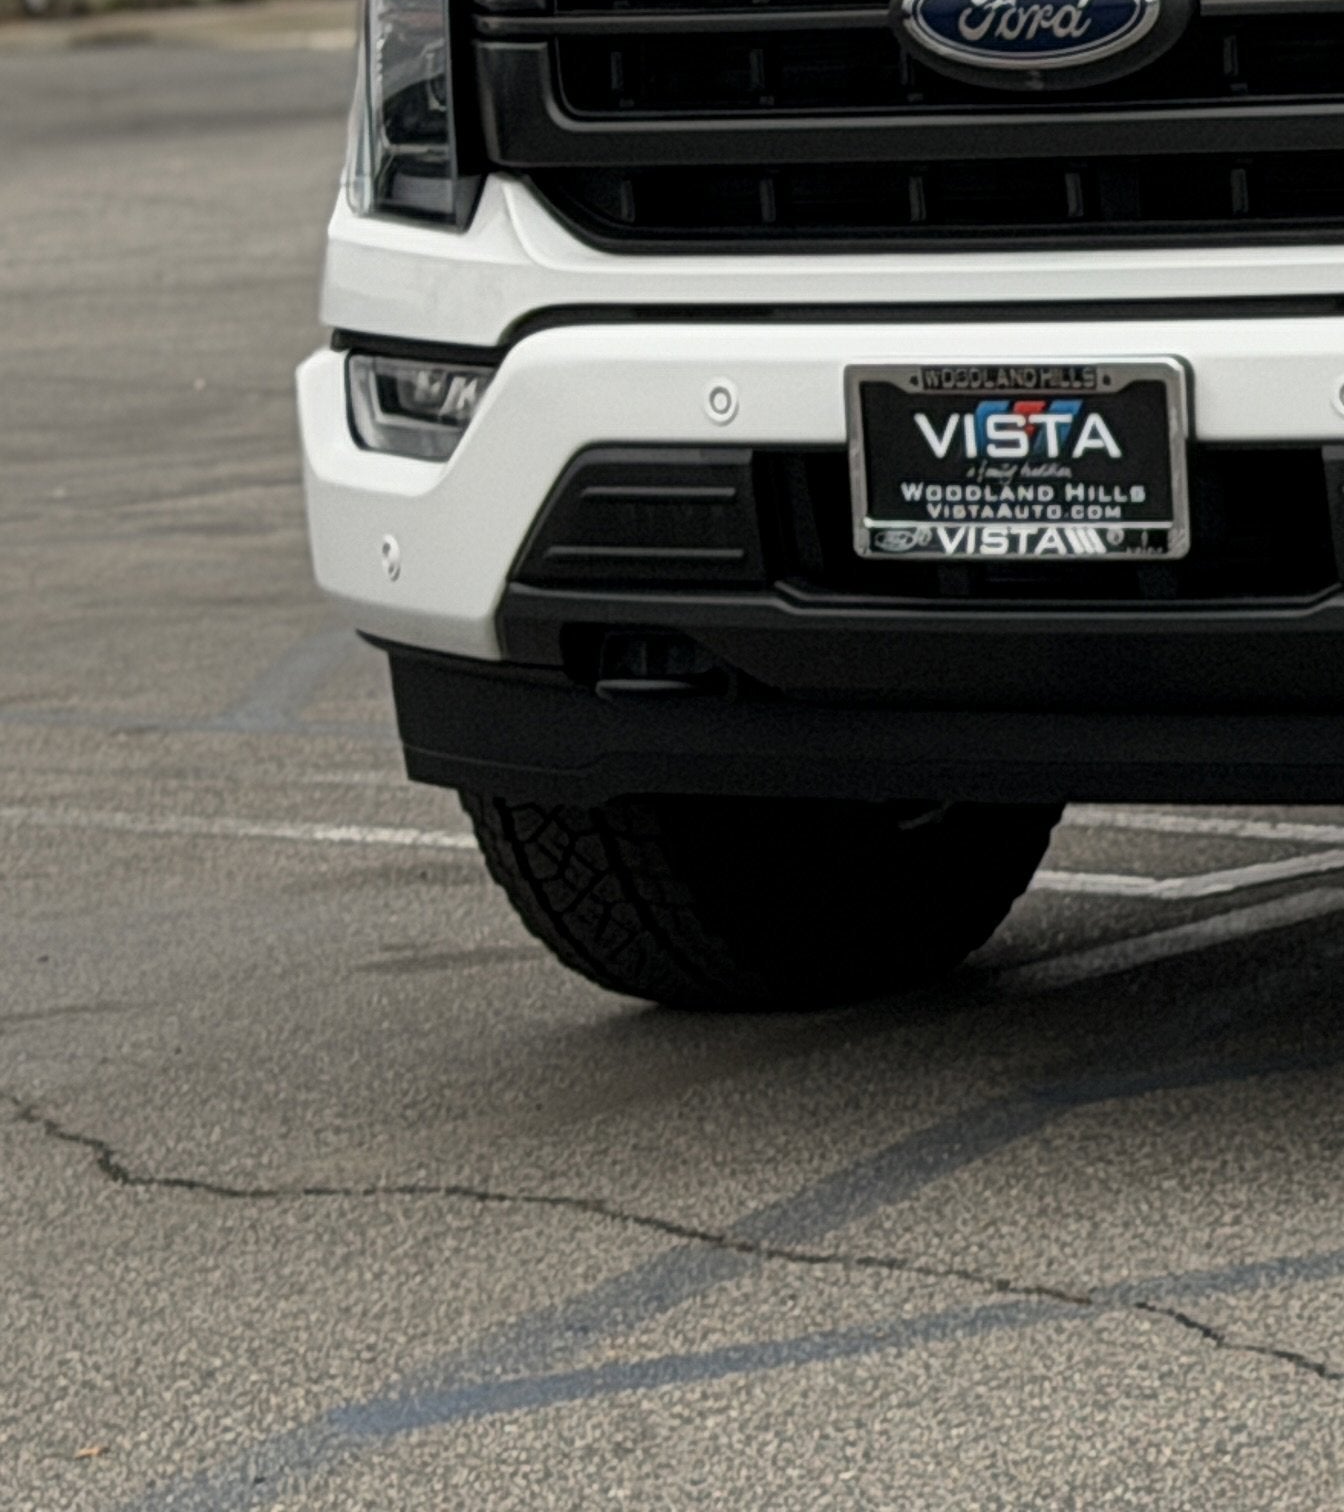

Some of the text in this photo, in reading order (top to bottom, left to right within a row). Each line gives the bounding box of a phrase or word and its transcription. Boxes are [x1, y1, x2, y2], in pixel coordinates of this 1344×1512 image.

[924, 366, 1098, 389] WOODLAND HILLS
[914, 412, 1122, 459] VISTA
[900, 482, 1147, 503] WOODLAND HILLS
[936, 526, 1068, 555] VISTA
